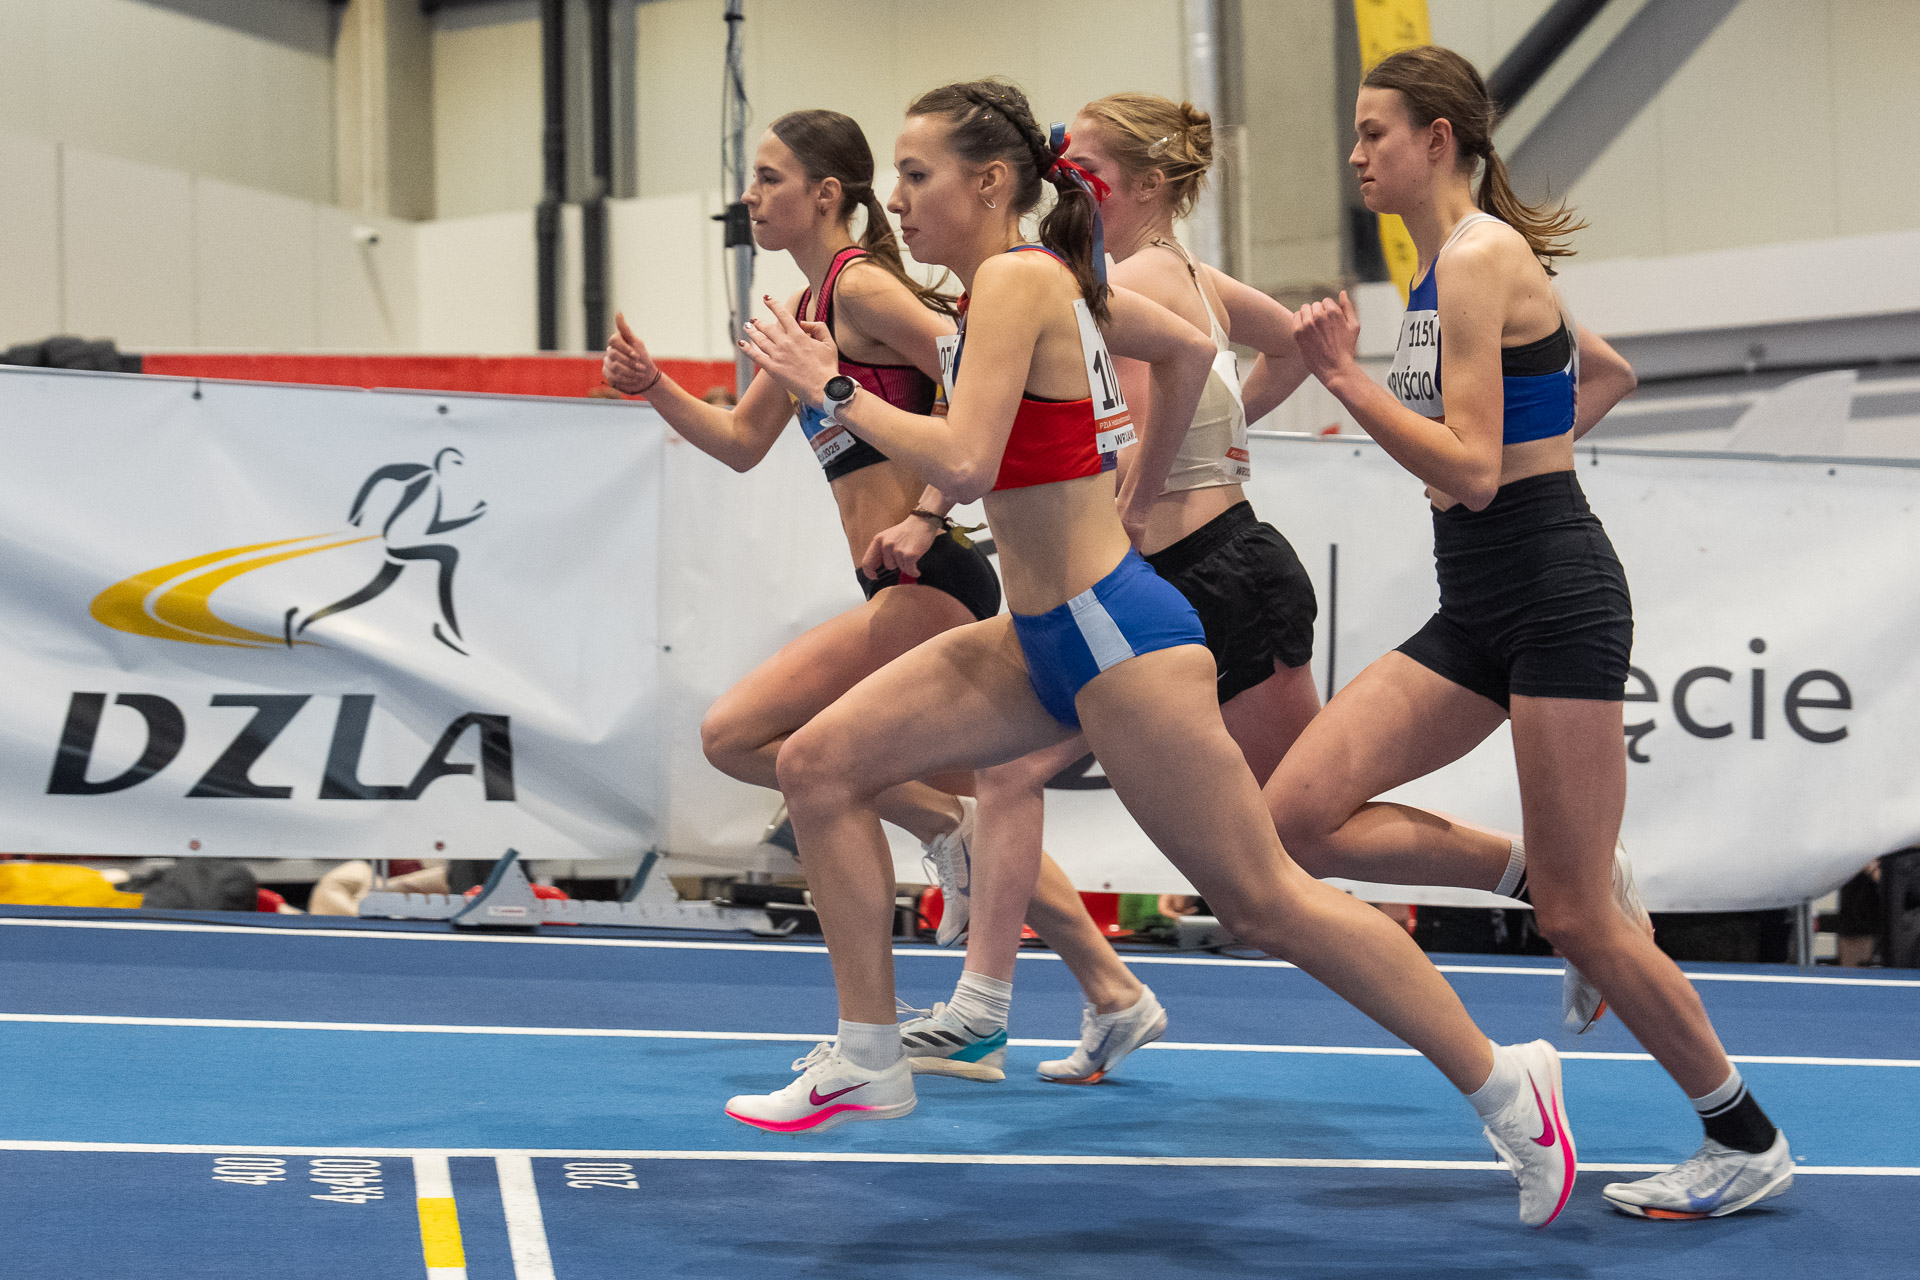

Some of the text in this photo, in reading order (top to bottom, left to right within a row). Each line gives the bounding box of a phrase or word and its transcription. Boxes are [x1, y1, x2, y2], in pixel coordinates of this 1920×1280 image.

[1409, 320, 1435, 347] 1151
[1388, 365, 1434, 400] RYŚCIO
[45, 691, 518, 802] DZLA
[211, 1157, 287, 1185] 400
[309, 1158, 385, 1204] 4x400
[562, 1162, 640, 1190] 200
